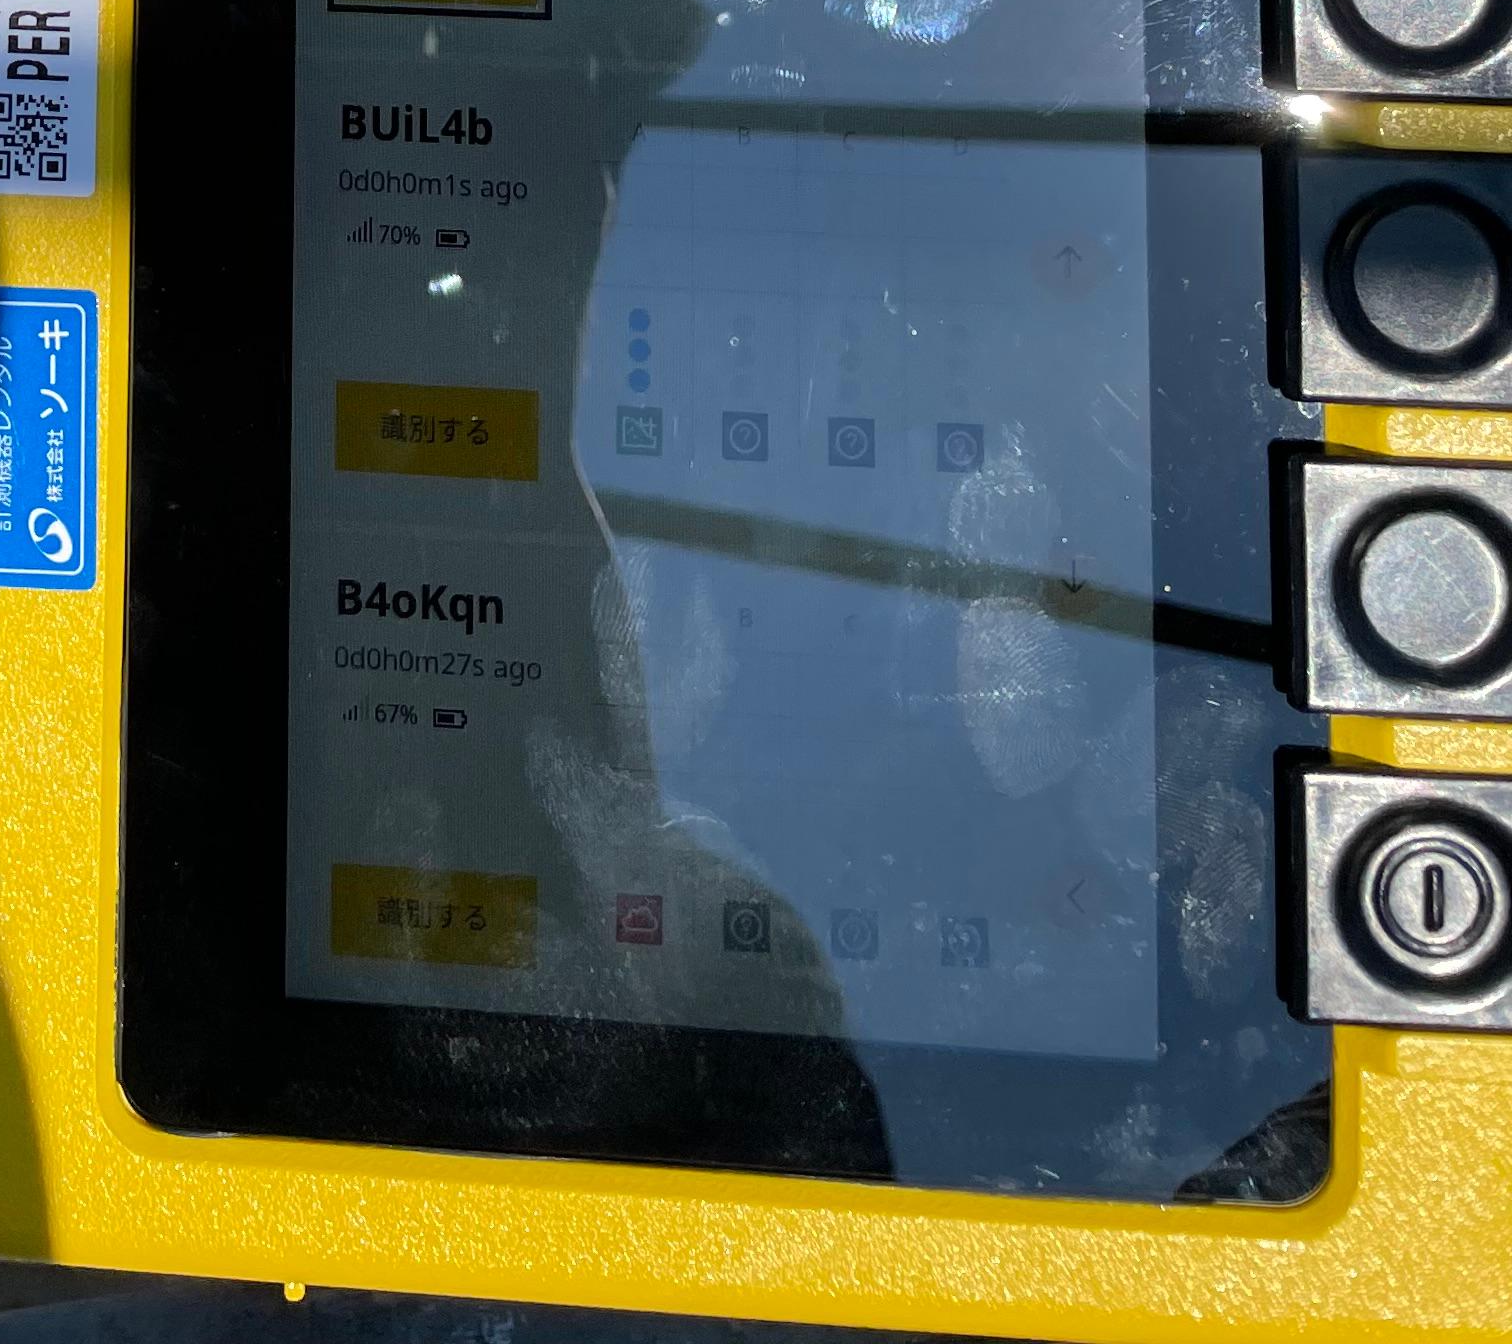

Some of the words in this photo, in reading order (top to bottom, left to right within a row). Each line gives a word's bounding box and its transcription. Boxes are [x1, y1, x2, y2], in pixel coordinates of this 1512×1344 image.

[341, 102, 494, 146] BUiL4b
[338, 167, 473, 198] 0d0h0m1s
[479, 178, 529, 207] ago
[378, 223, 422, 246] 70%
[38, 318, 70, 419] ソーキ
[380, 412, 489, 446] 識別する
[45, 428, 65, 503] 株式会社
[336, 577, 505, 636] B4oKqn
[333, 645, 486, 678] 0d0h0m27s
[492, 657, 543, 688] ago
[373, 702, 419, 726] 67%
